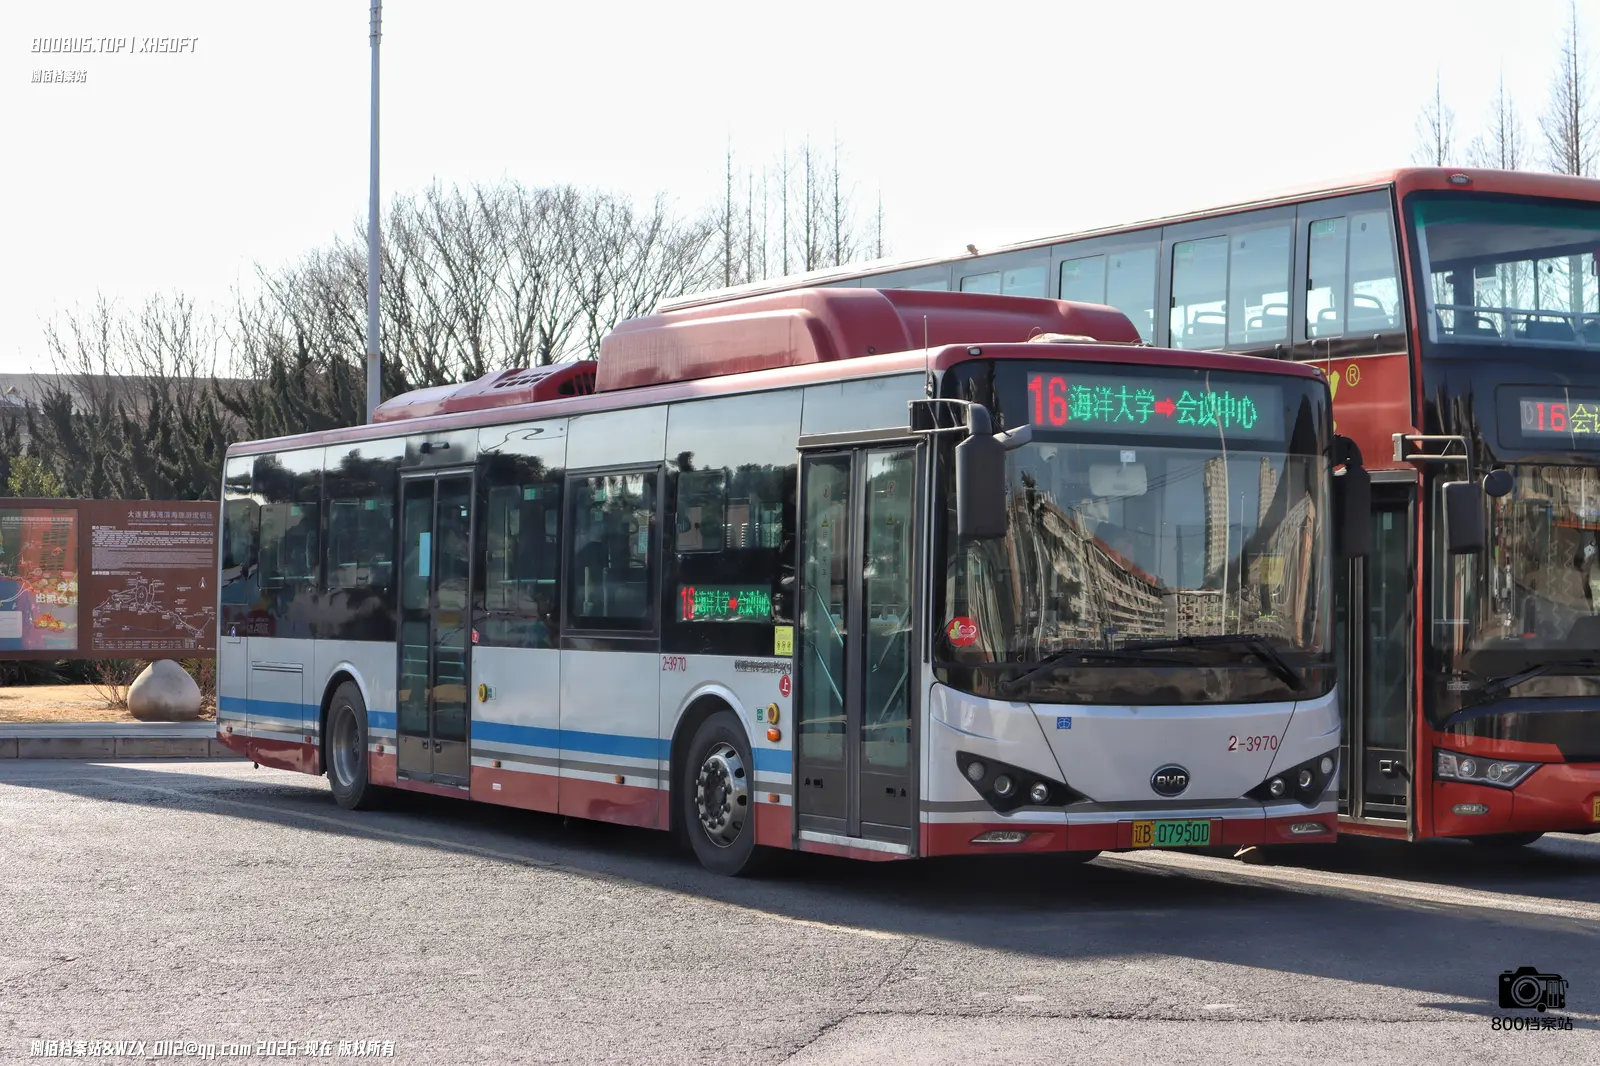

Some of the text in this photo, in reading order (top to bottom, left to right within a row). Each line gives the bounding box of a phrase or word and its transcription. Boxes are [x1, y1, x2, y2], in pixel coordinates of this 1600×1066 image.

[1028, 375, 1257, 429] 16 海洋大学 会议中心
[1536, 403, 1567, 432] 16
[681, 586, 695, 620] 16
[662, 656, 687, 672] 2-3970
[1227, 735, 1278, 752] 2-3970
[1157, 775, 1186, 785] BYD
[1158, 823, 1209, 843] 07950D
